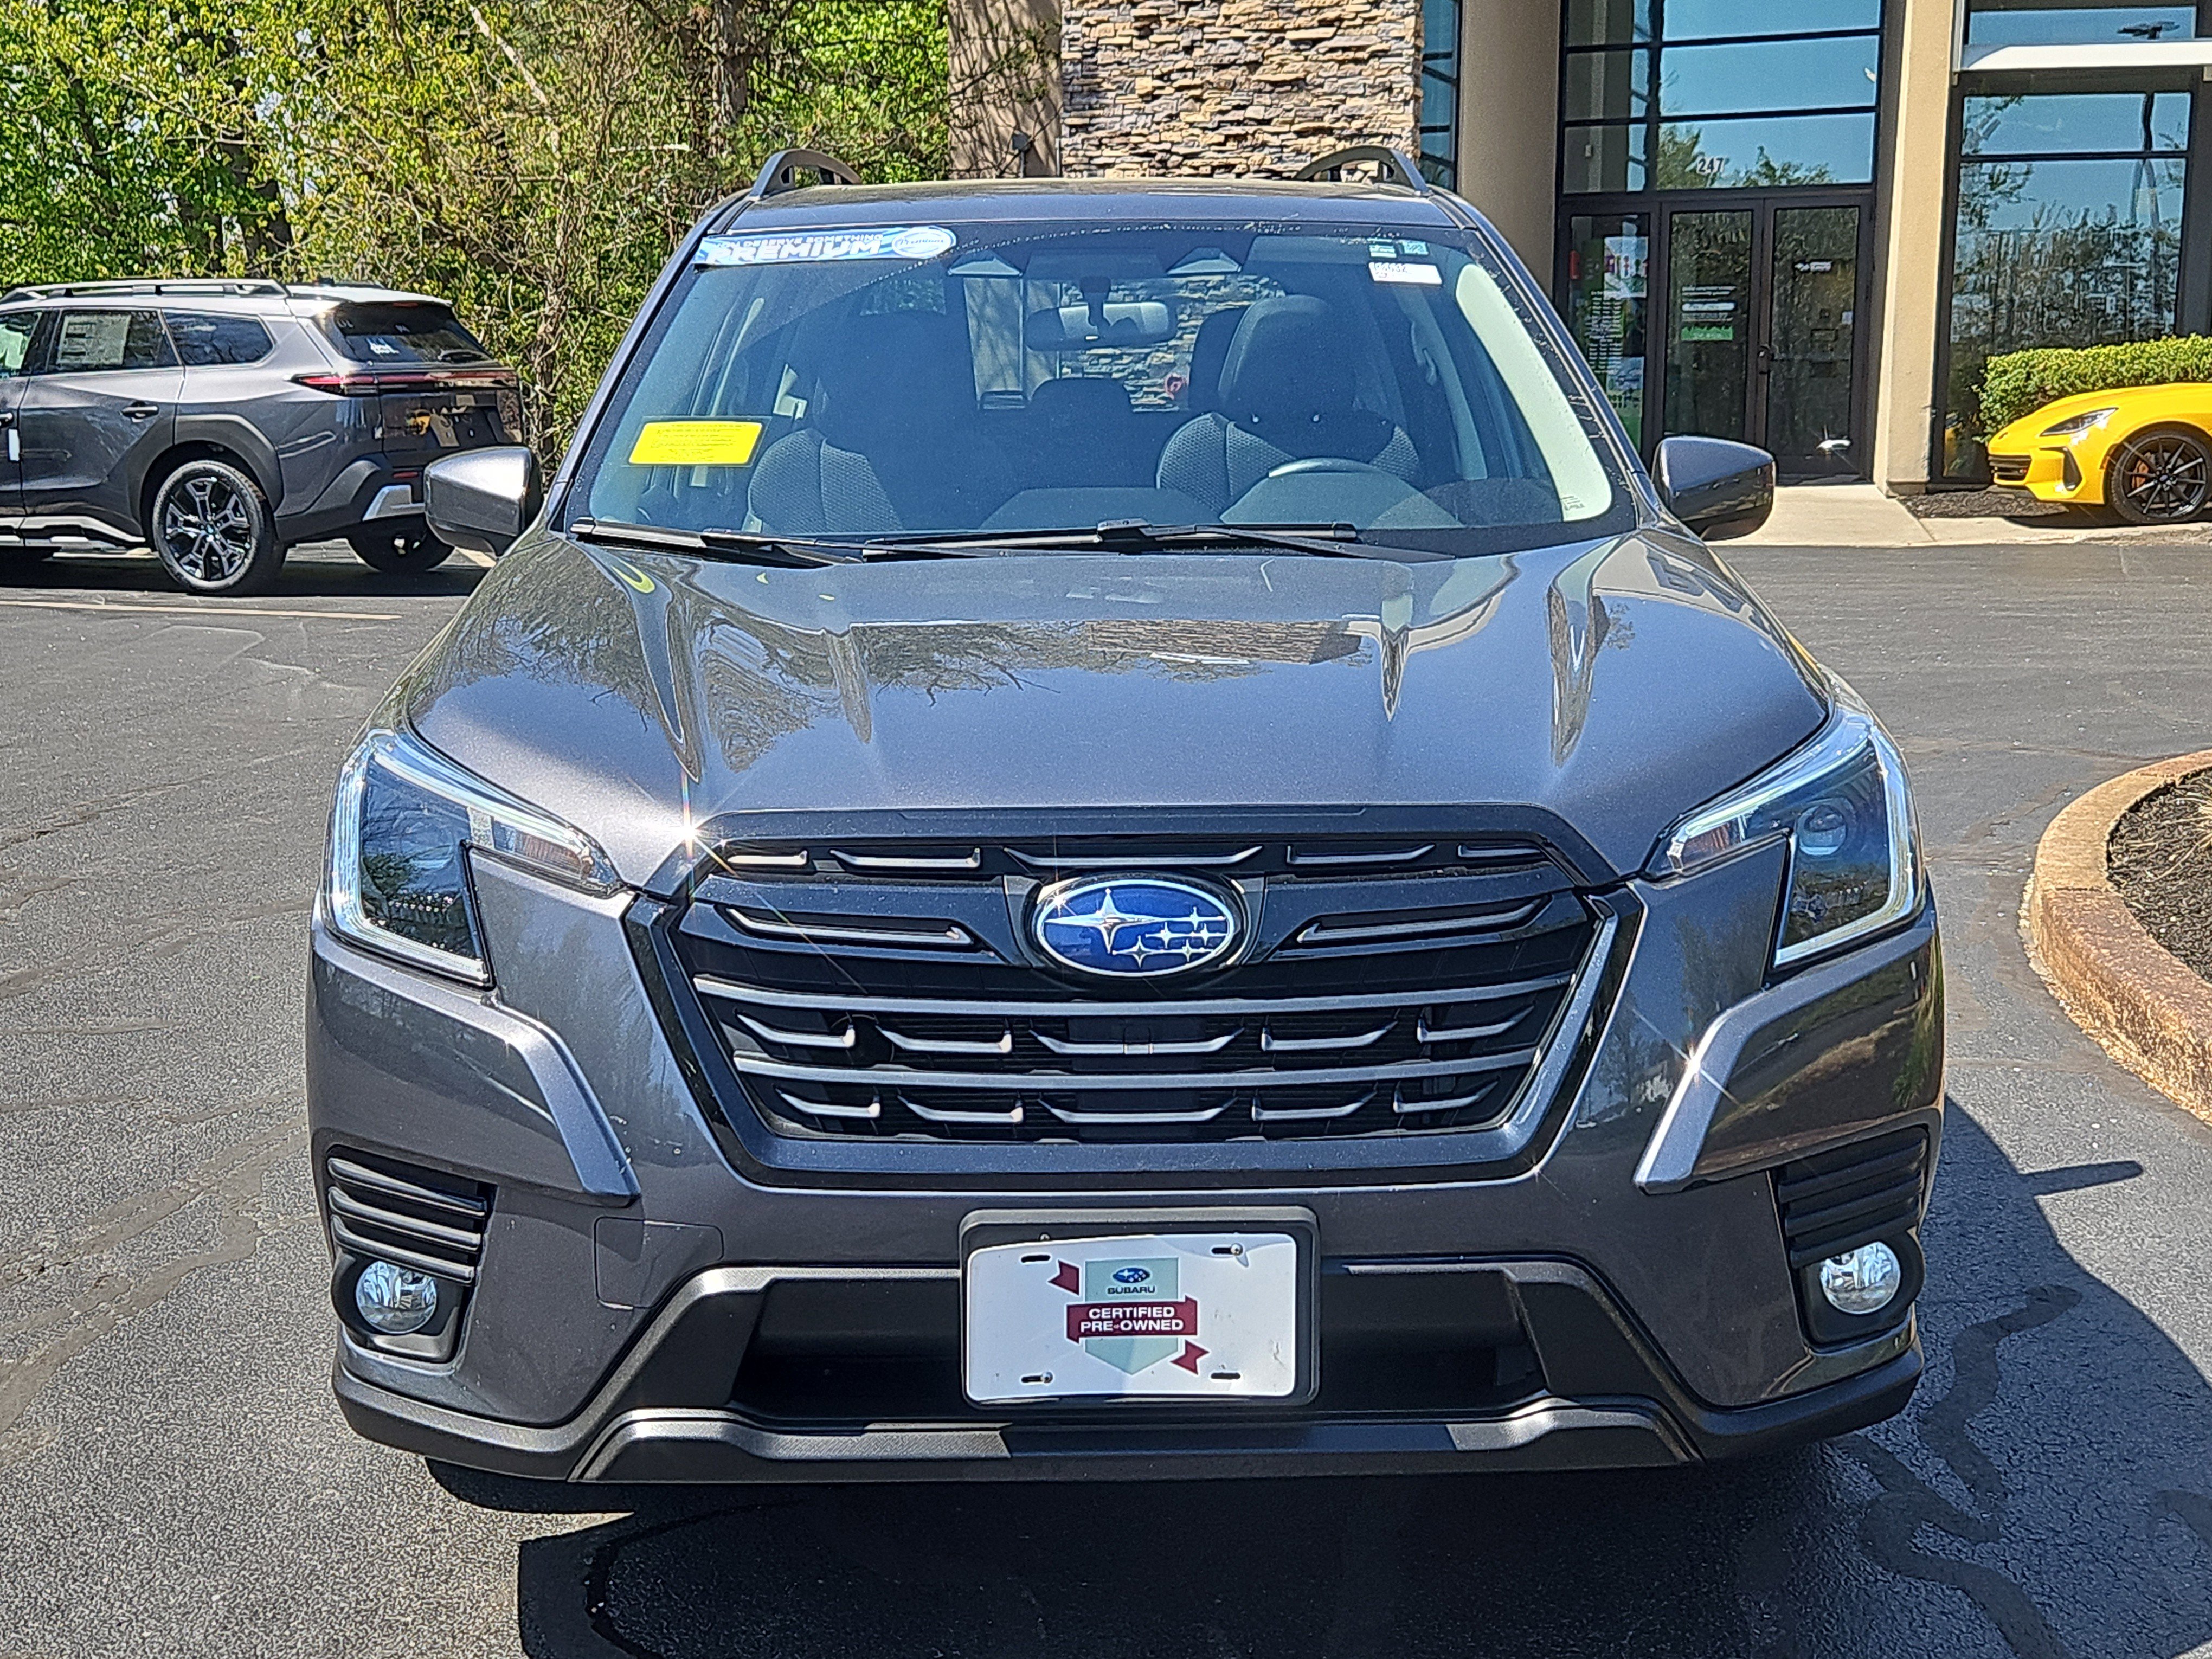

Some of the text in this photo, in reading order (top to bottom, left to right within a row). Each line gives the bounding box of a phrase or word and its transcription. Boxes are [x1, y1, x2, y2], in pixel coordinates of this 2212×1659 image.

[1698, 157, 1724, 173] 247
[743, 237, 802, 248] DESERVE
[806, 234, 884, 245] SOMETHING
[706, 239, 882, 263] PREMIUM
[1107, 1285, 1156, 1295] SUBARU
[1089, 1306, 1175, 1320] CERTIFIED
[1080, 1319, 1184, 1333] PRE-OWNED
